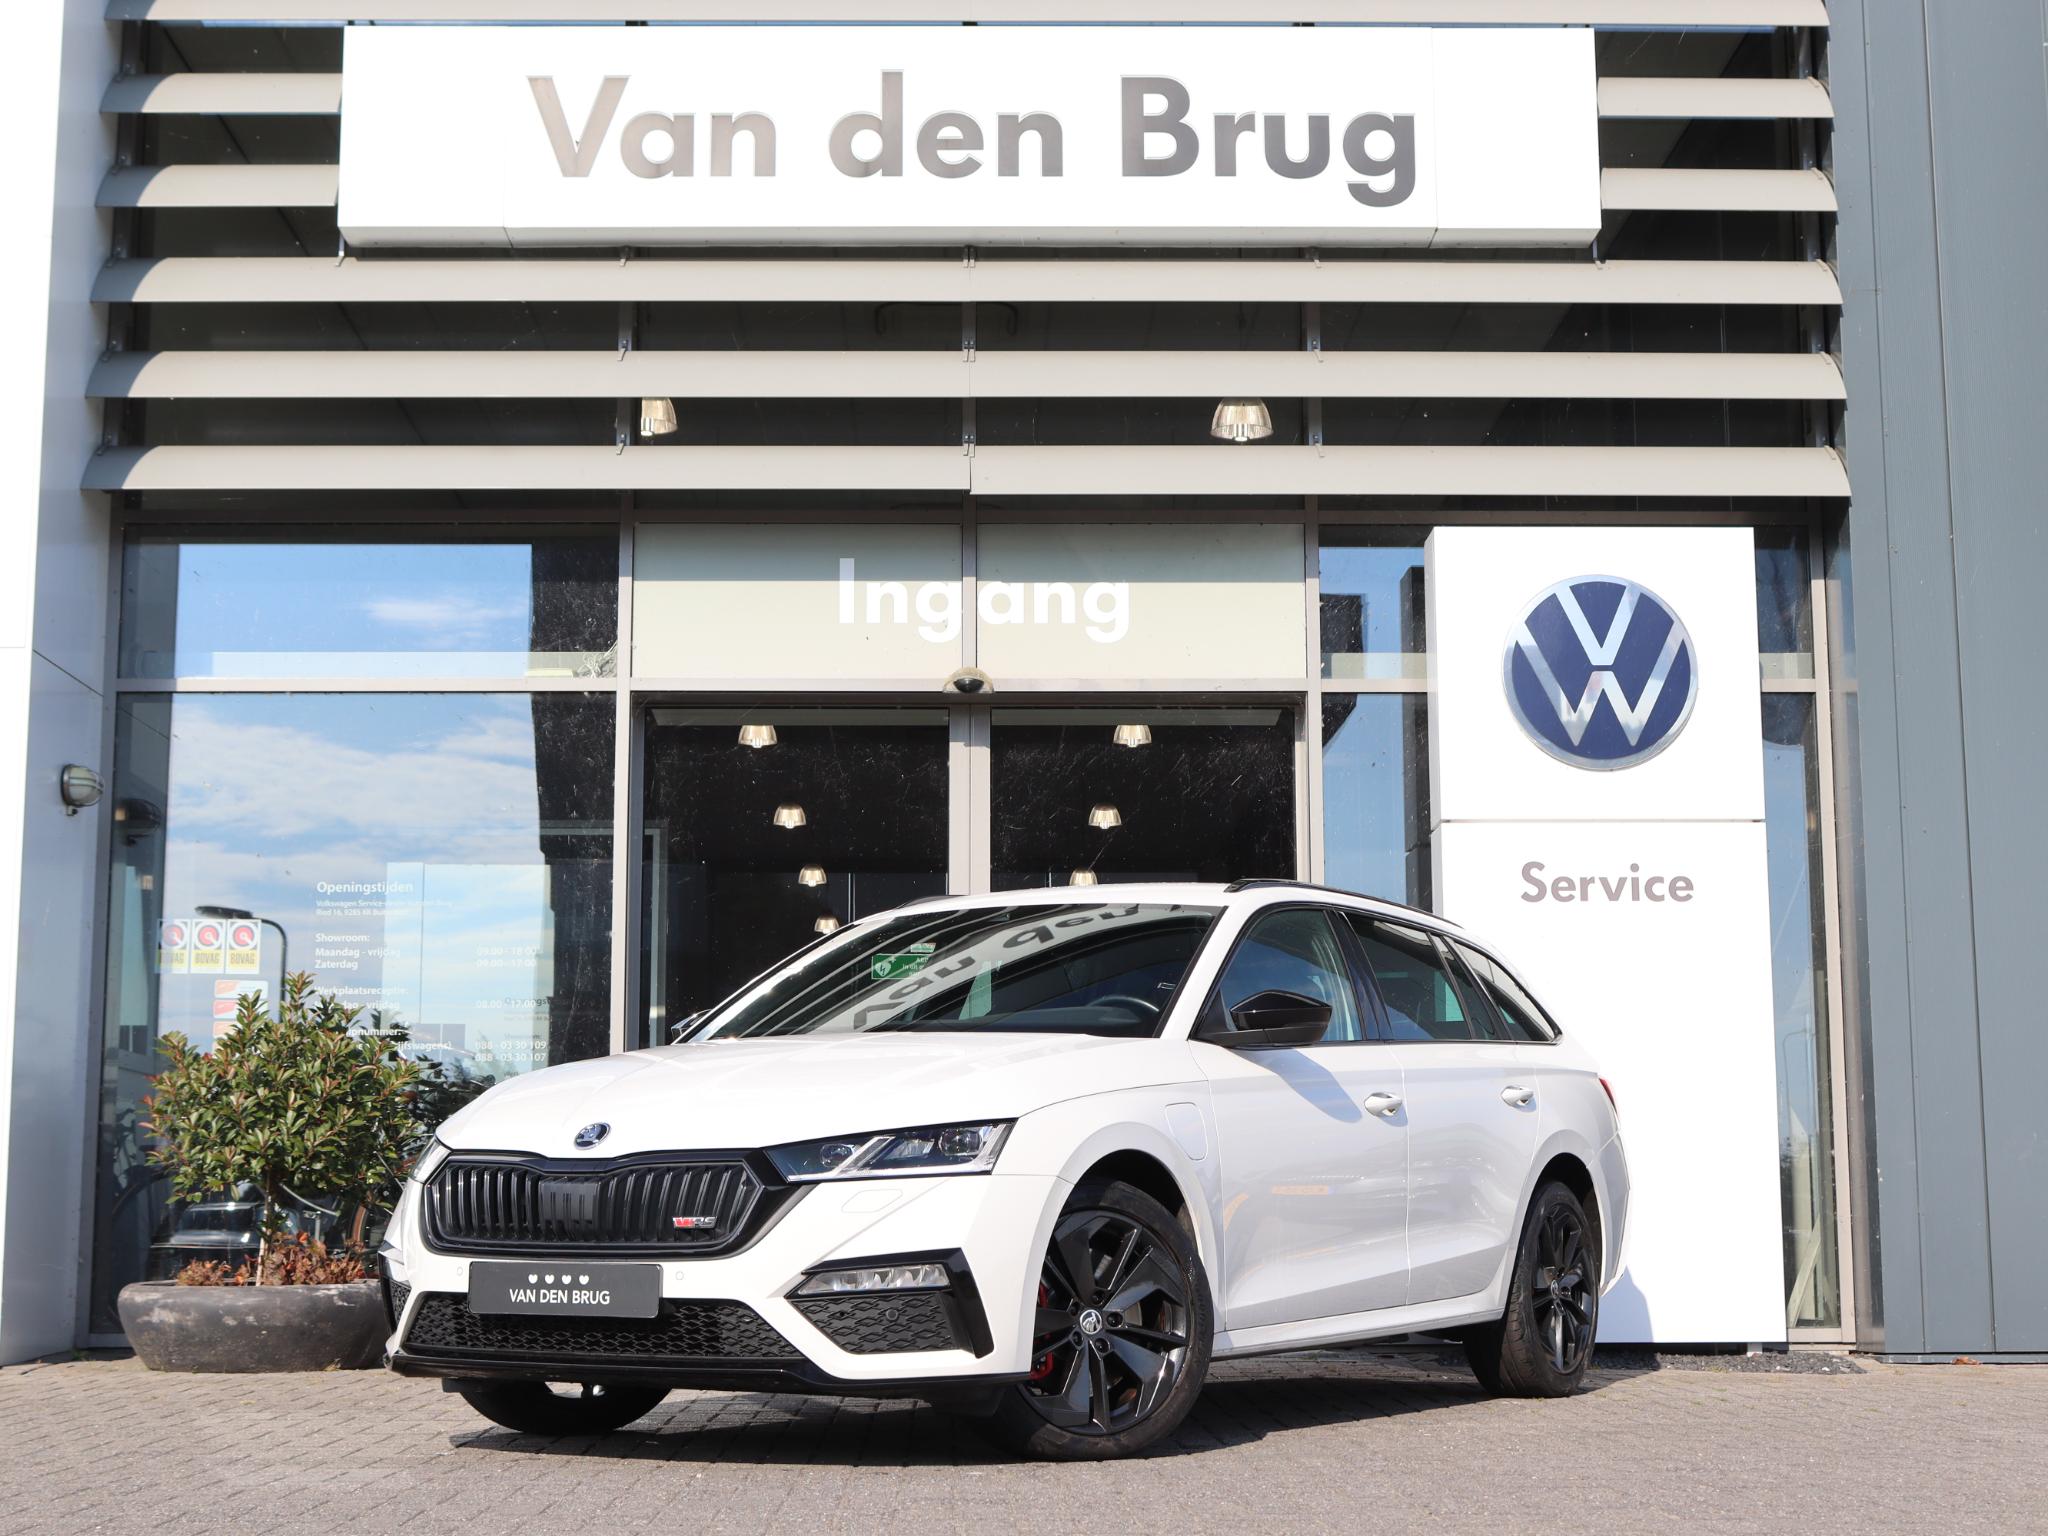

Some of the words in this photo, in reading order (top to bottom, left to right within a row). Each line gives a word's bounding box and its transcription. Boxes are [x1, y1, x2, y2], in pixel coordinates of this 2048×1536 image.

[526, 75, 777, 179] Van
[829, 69, 1064, 179] den
[1120, 75, 1416, 208] Brug
[839, 558, 1130, 643] Ingang
[316, 881, 414, 896] Openingstijden
[1520, 861, 1695, 903] Service
[314, 932, 371, 943] Showroom:
[194, 952, 220, 964] BOVAG
[230, 952, 255, 965] BOVAG
[314, 948, 360, 959] Maandag
[367, 948, 401, 959] vrijdag
[314, 959, 359, 971] Zaterdag
[529, 1040, 547, 1050] 109
[509, 1288, 536, 1303] VAN
[539, 1289, 568, 1304] DEN
[572, 1290, 611, 1305] BRUG
